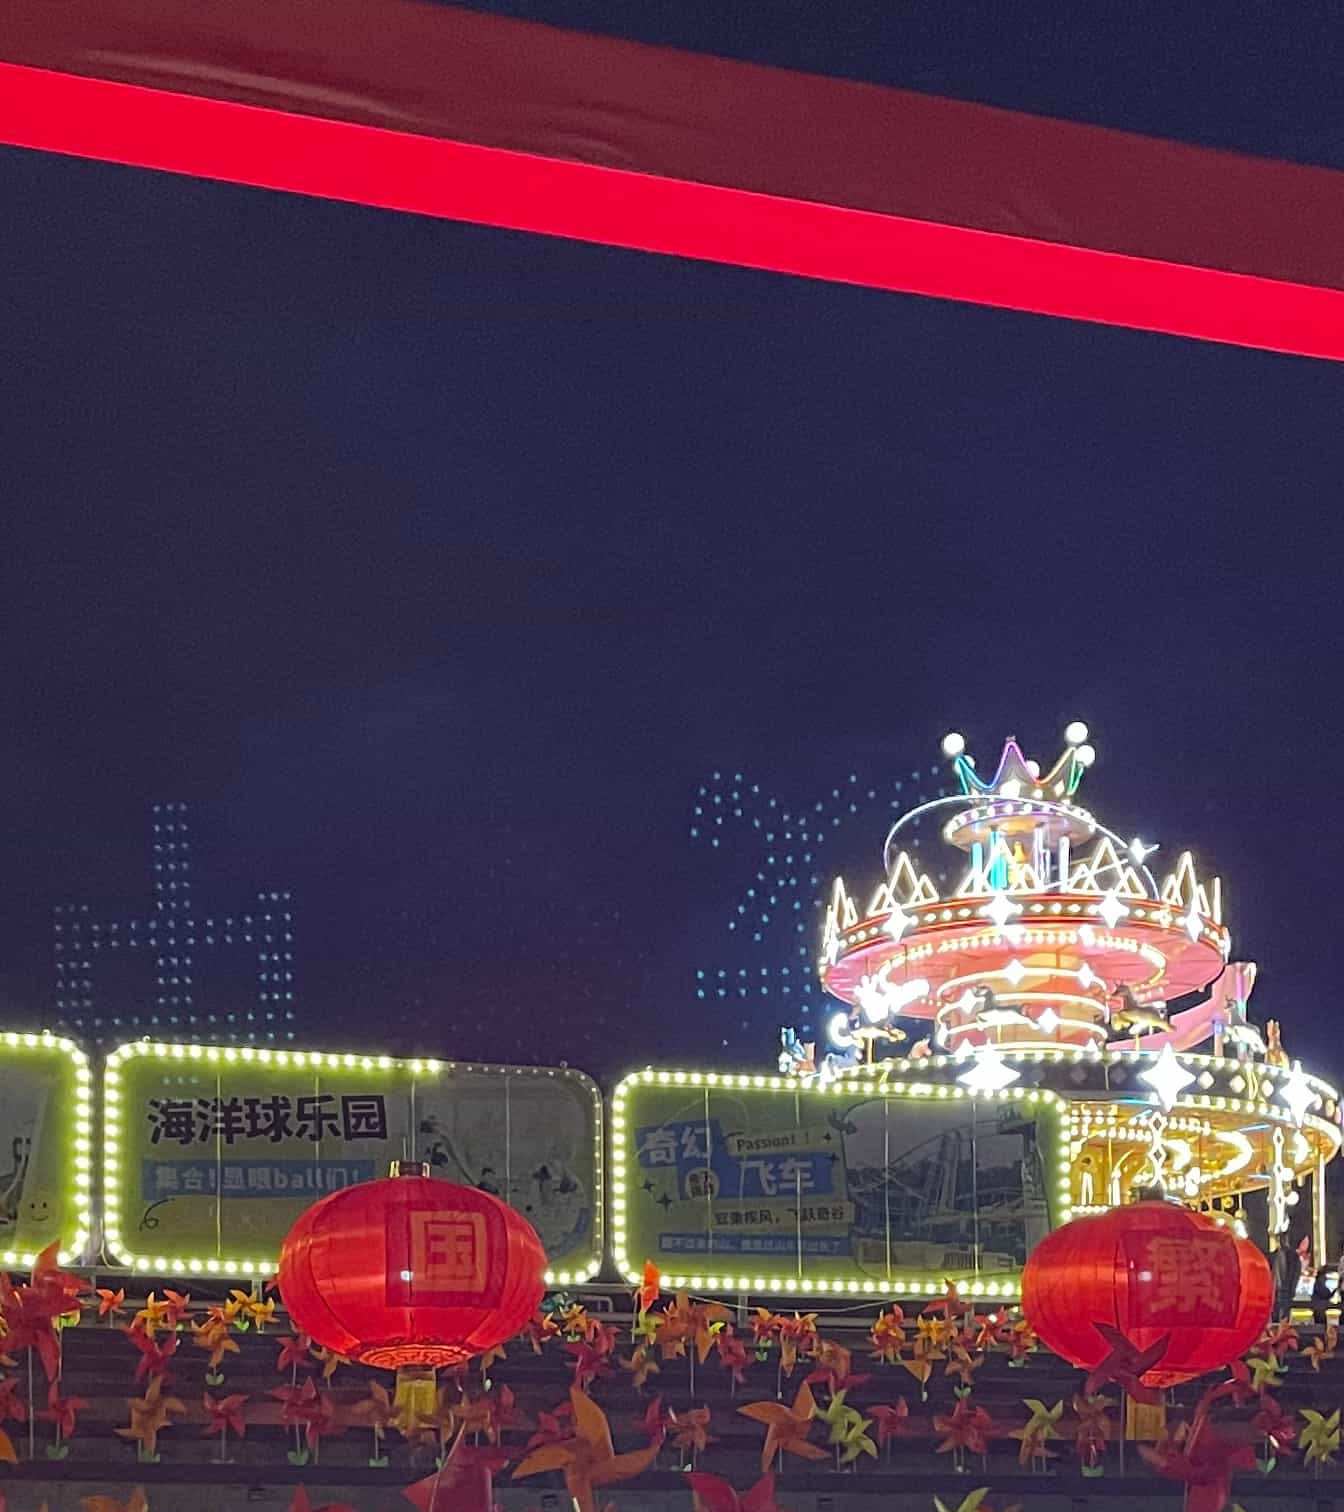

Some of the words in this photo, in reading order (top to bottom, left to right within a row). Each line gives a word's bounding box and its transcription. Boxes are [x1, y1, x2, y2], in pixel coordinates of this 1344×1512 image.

[146, 1095, 389, 1145] 海洋球乐园
[642, 1126, 712, 1164] 奇幻
[739, 1159, 816, 1196] 飞车
[409, 1209, 488, 1293] 国
[1146, 1235, 1226, 1314] 繁
